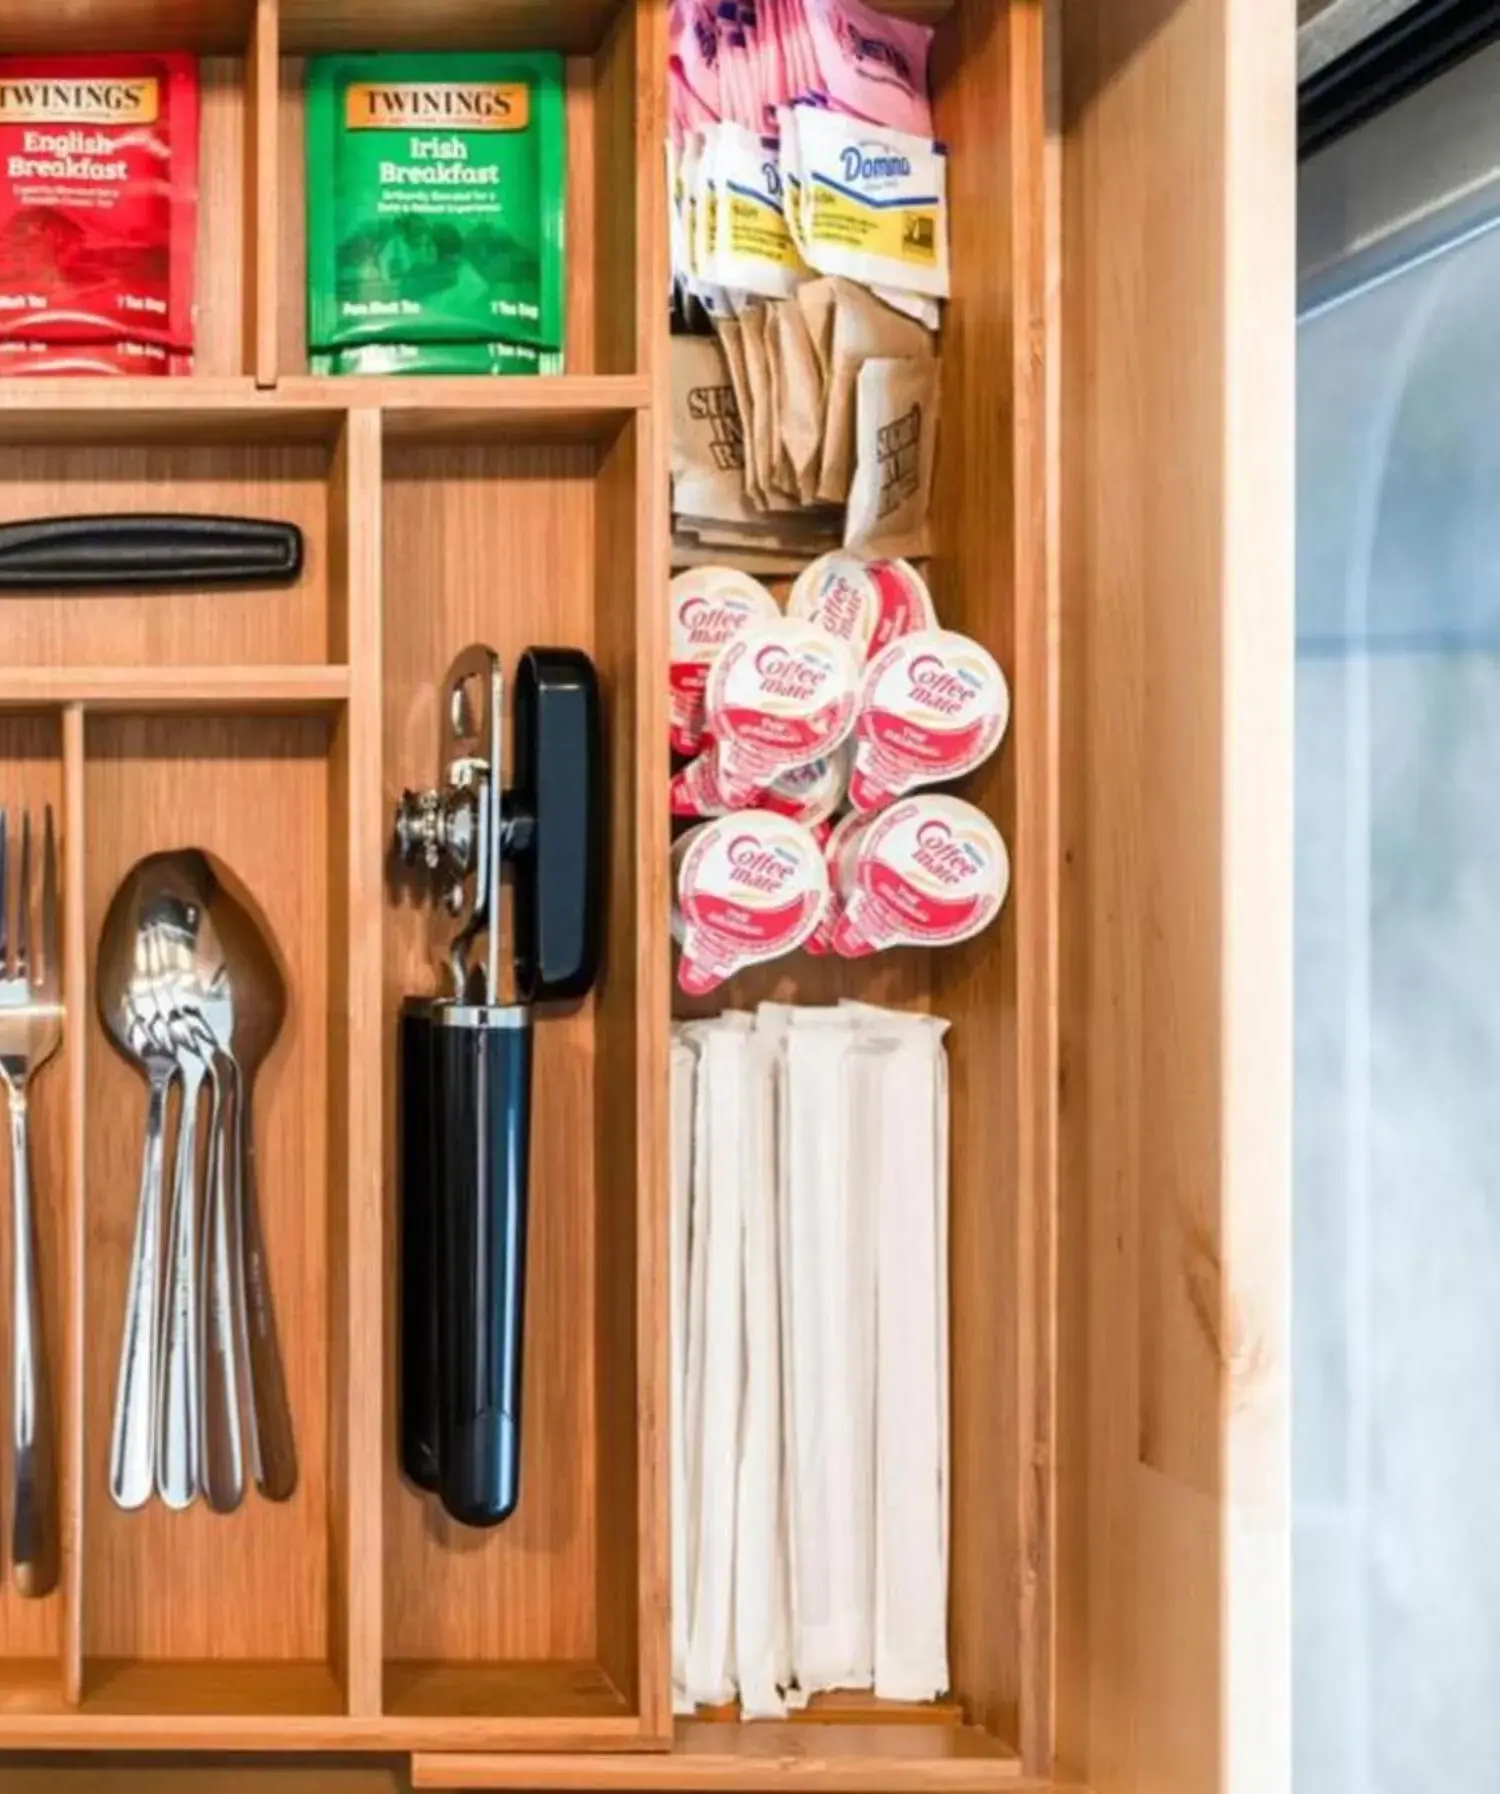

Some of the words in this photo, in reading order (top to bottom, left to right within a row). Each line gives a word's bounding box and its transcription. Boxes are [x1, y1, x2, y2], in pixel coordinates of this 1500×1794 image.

[363, 90, 512, 116] TWININGS
[23, 131, 114, 159] English
[409, 137, 468, 160] Irish
[7, 155, 128, 181] Breakfast
[379, 160, 501, 185] Breakfast
[839, 146, 912, 182] Domino
[678, 597, 749, 630] Coffee
[755, 644, 827, 686] Coffee
[907, 654, 977, 704] Coffee
[907, 686, 963, 715] mate
[726, 834, 796, 879] Coffee
[915, 819, 978, 878] Coffee
[728, 866, 784, 895] mate
[910, 848, 961, 886] mate
